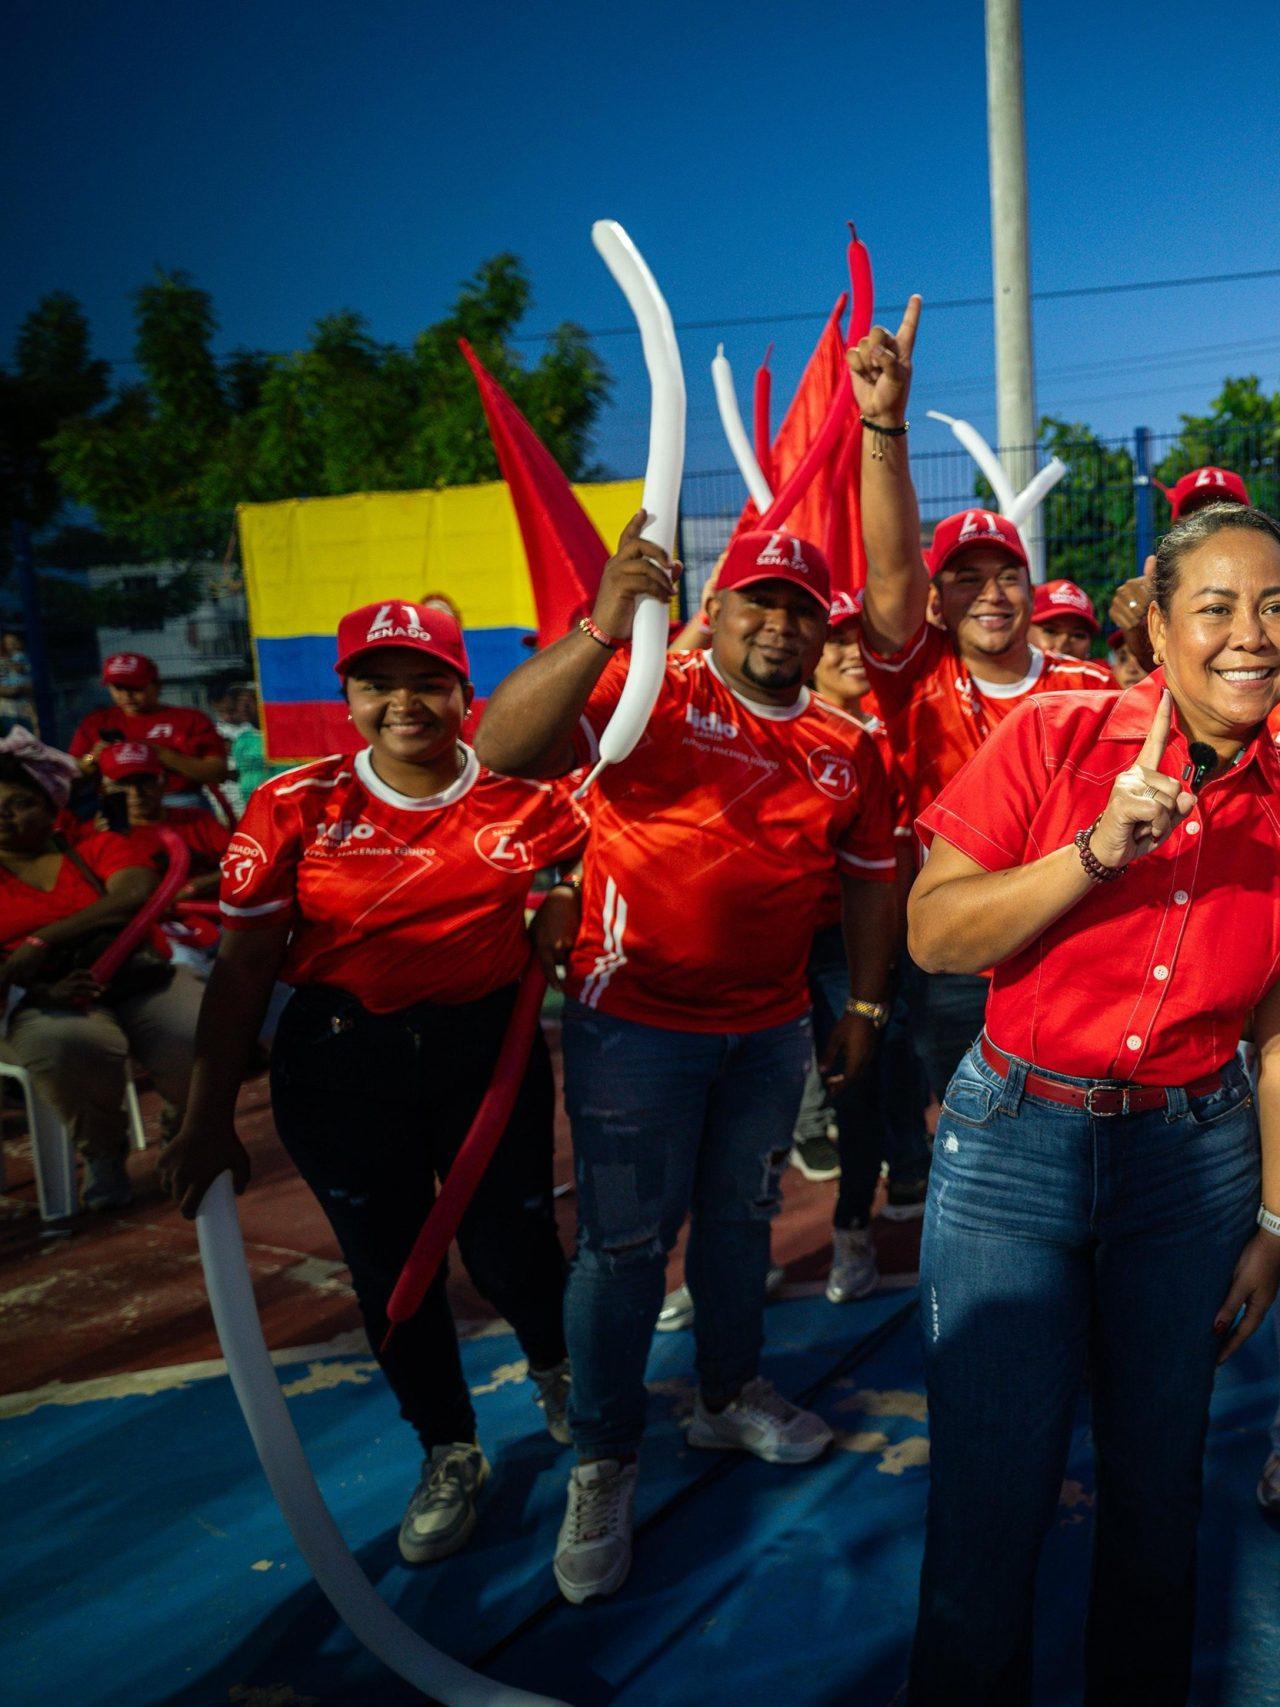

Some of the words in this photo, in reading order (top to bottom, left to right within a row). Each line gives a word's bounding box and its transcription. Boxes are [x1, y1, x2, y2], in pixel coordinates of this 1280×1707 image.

[1195, 469, 1226, 487] L1
[960, 512, 999, 535] L1
[759, 533, 805, 560] L1
[755, 556, 809, 574] SENADO
[368, 604, 424, 634] L1
[366, 626, 431, 642] SENADO
[818, 763, 851, 790] L1
[489, 835, 529, 863] L1
